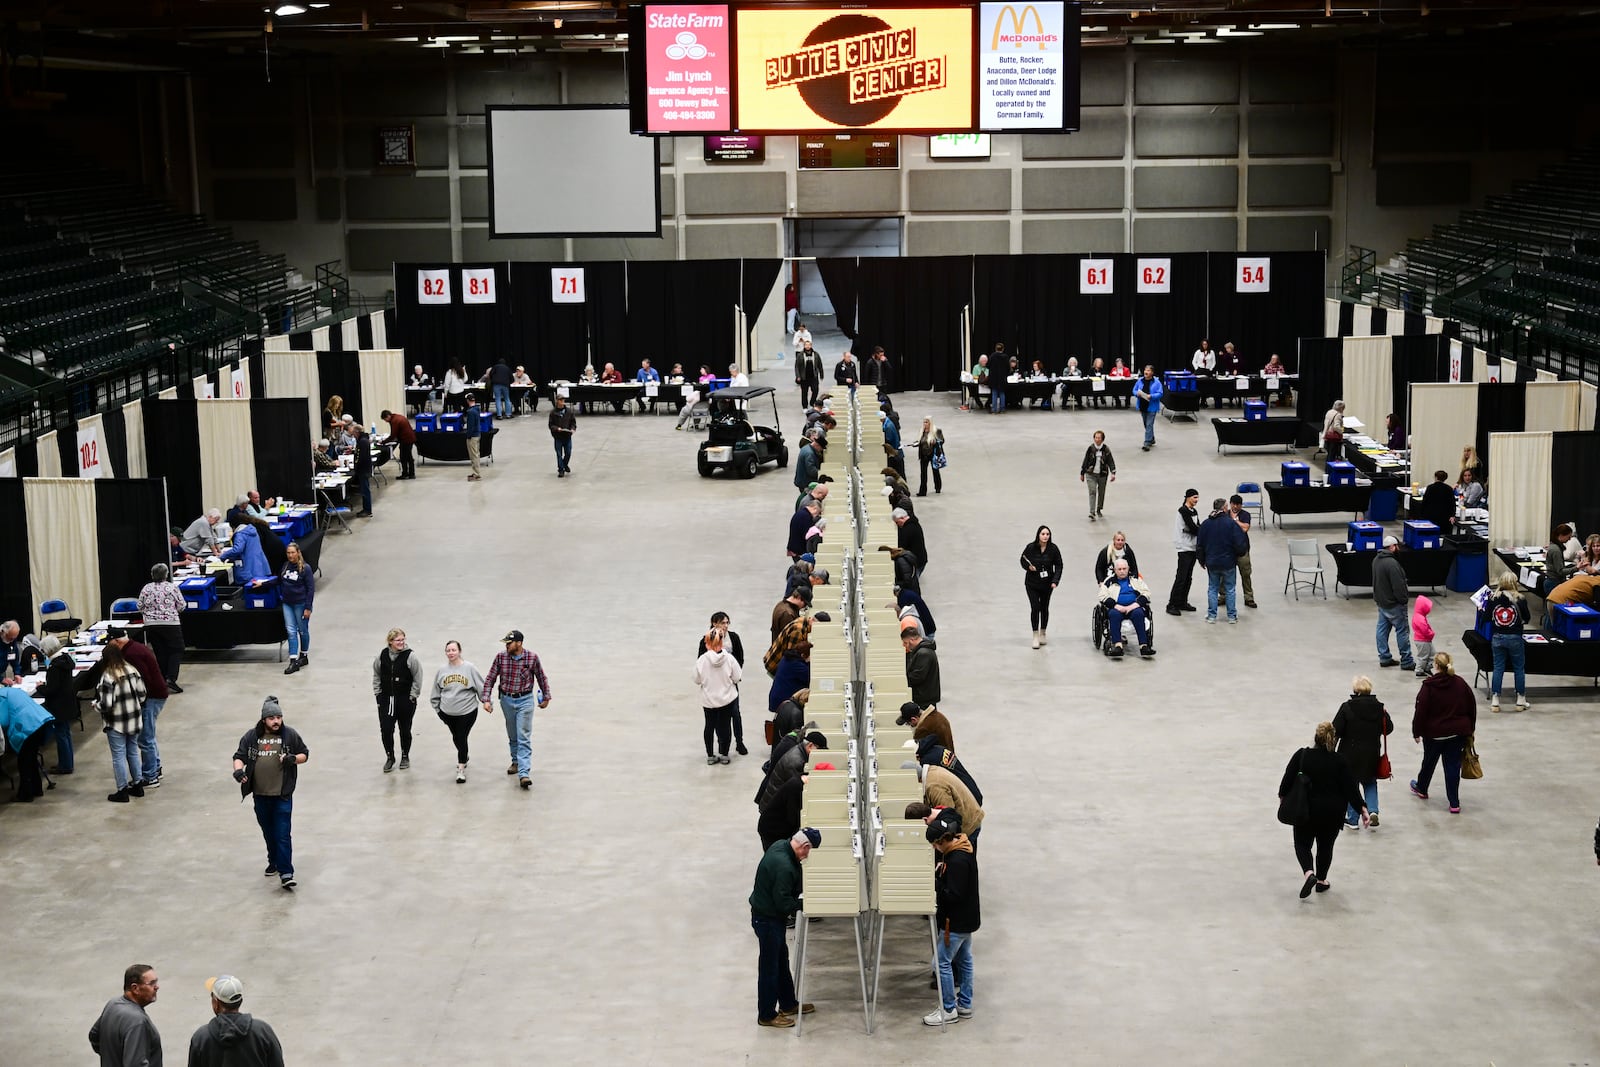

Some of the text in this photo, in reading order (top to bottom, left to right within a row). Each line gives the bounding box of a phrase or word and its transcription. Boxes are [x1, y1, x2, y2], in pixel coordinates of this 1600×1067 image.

[1000, 34, 1058, 42] McDonald's
[766, 30, 910, 84] BUTTE CIVIC
[999, 56, 1019, 64] Butte,
[665, 71, 712, 83] Jim Lynch
[853, 57, 941, 98] CENTER
[987, 67, 1057, 75] Anaconda, Deer Lodge
[648, 86, 729, 96] Insurance Agency Inc.
[992, 89, 1051, 97] Locally owned and
[675, 98, 699, 109] Dewey
[701, 98, 719, 107] Blvd.
[995, 100, 1025, 108] operated
[1026, 100, 1034, 108] by
[997, 111, 1045, 119] Gorman Family.
[1087, 267, 1107, 285] 6.1
[1143, 267, 1165, 285] 6.2
[1242, 266, 1264, 283] 5.4
[424, 278, 444, 296] 8.2
[469, 277, 489, 295] 8.1
[559, 277, 577, 294] 7.1
[80, 440, 98, 470] 10.2
